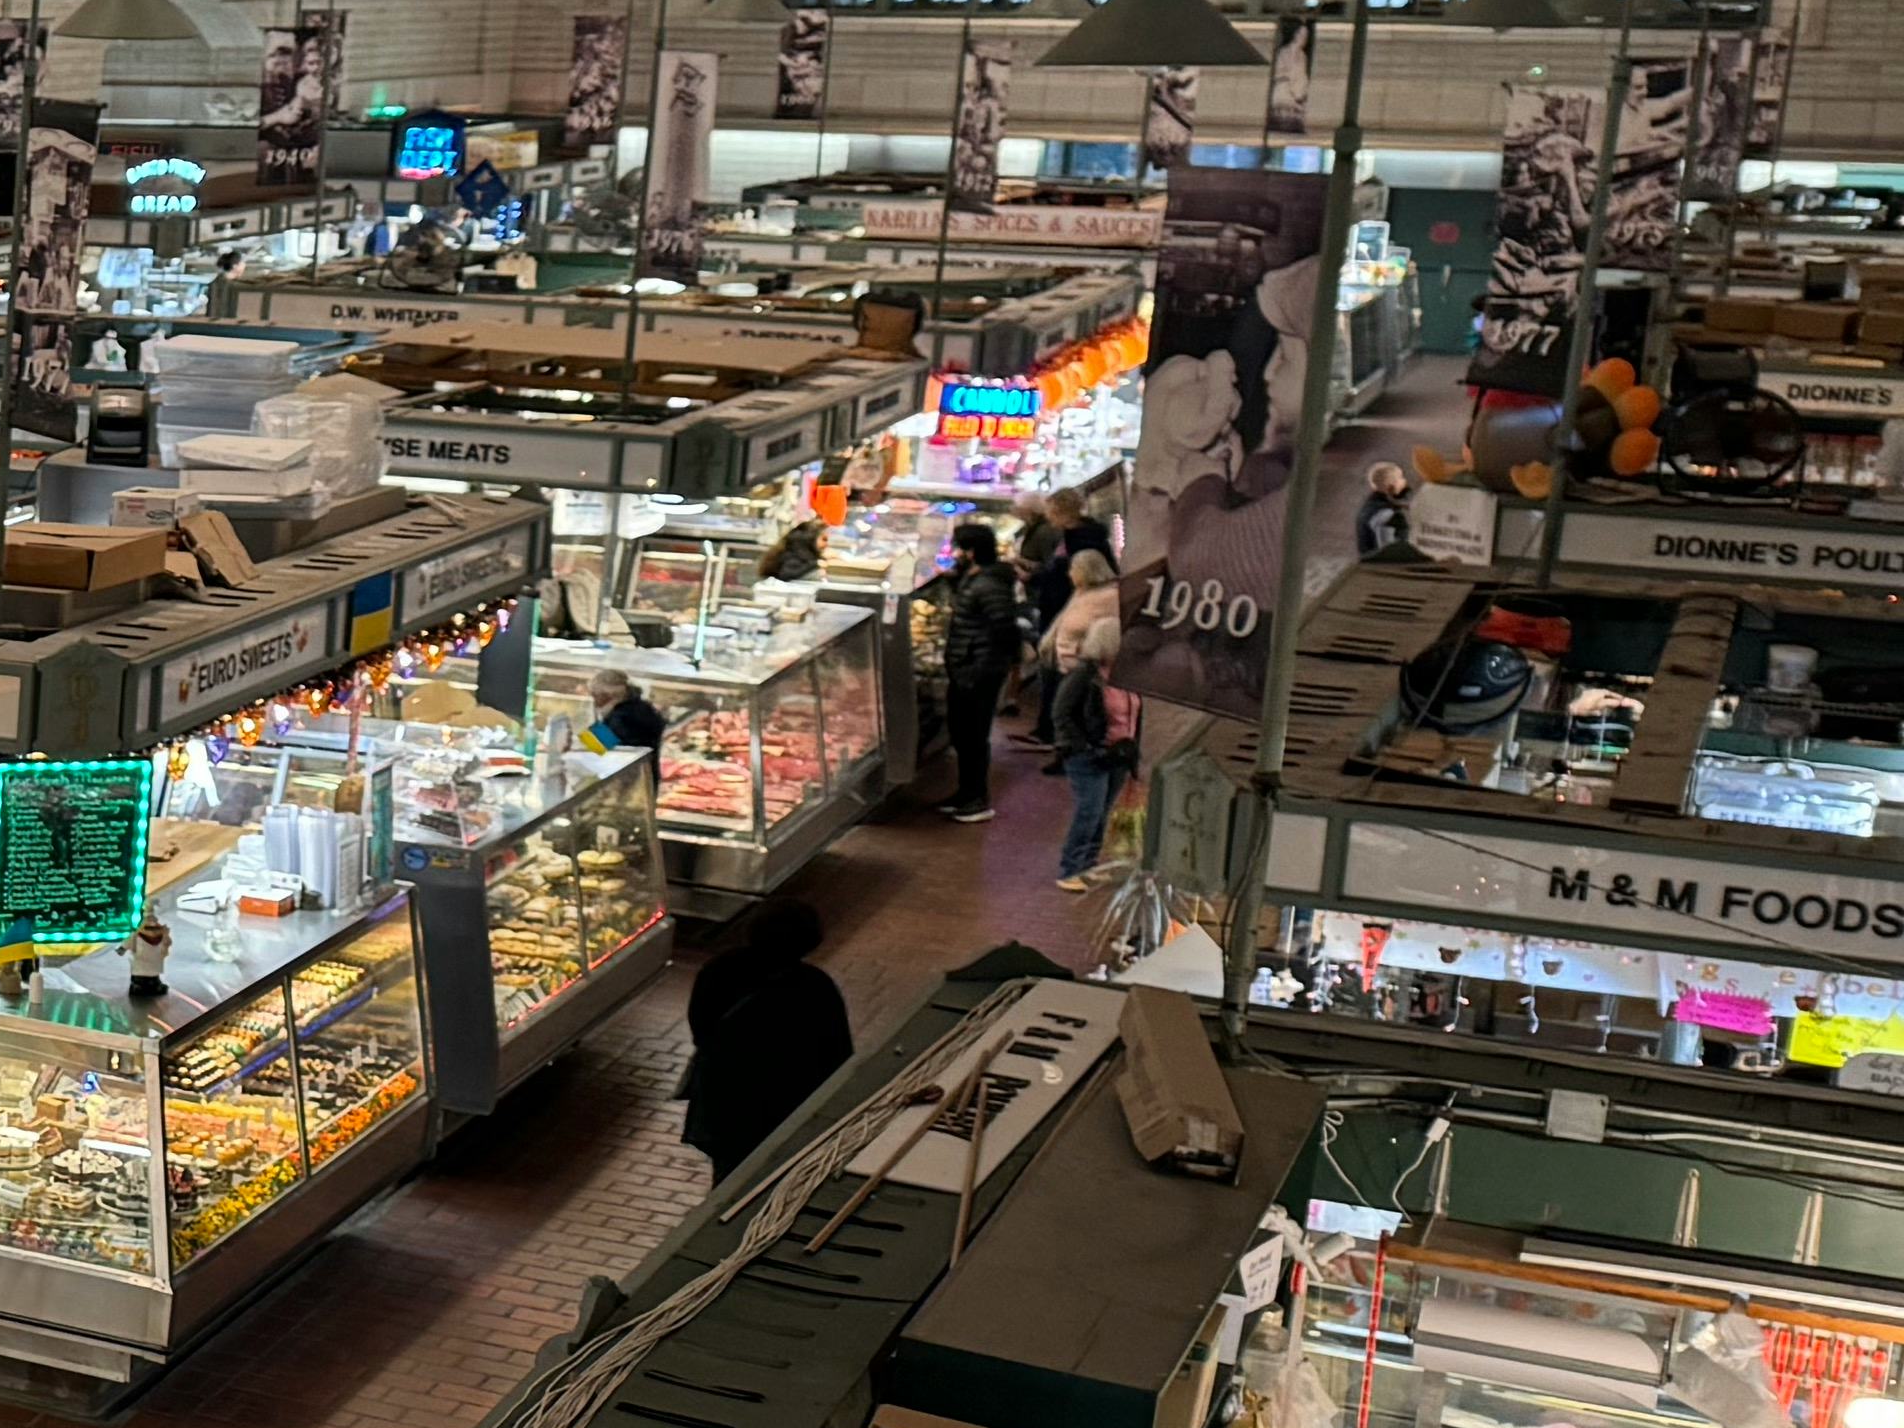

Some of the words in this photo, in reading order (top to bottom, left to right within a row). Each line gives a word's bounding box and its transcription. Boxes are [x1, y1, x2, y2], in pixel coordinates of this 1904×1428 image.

[405, 126, 455, 150] FISH
[1490, 318, 1560, 356] 1977
[1786, 382, 1893, 408] DIONNE'S
[427, 440, 511, 465] MEATS
[1654, 534, 1800, 566] DIONNE'S
[1140, 576, 1259, 640] 1980
[197, 655, 237, 694] EURO
[238, 632, 293, 677] SWEETS
[1547, 867, 1589, 901] M
[1604, 874, 1640, 909] &
[1656, 878, 1698, 914] M
[1719, 884, 1904, 939] FOODS
